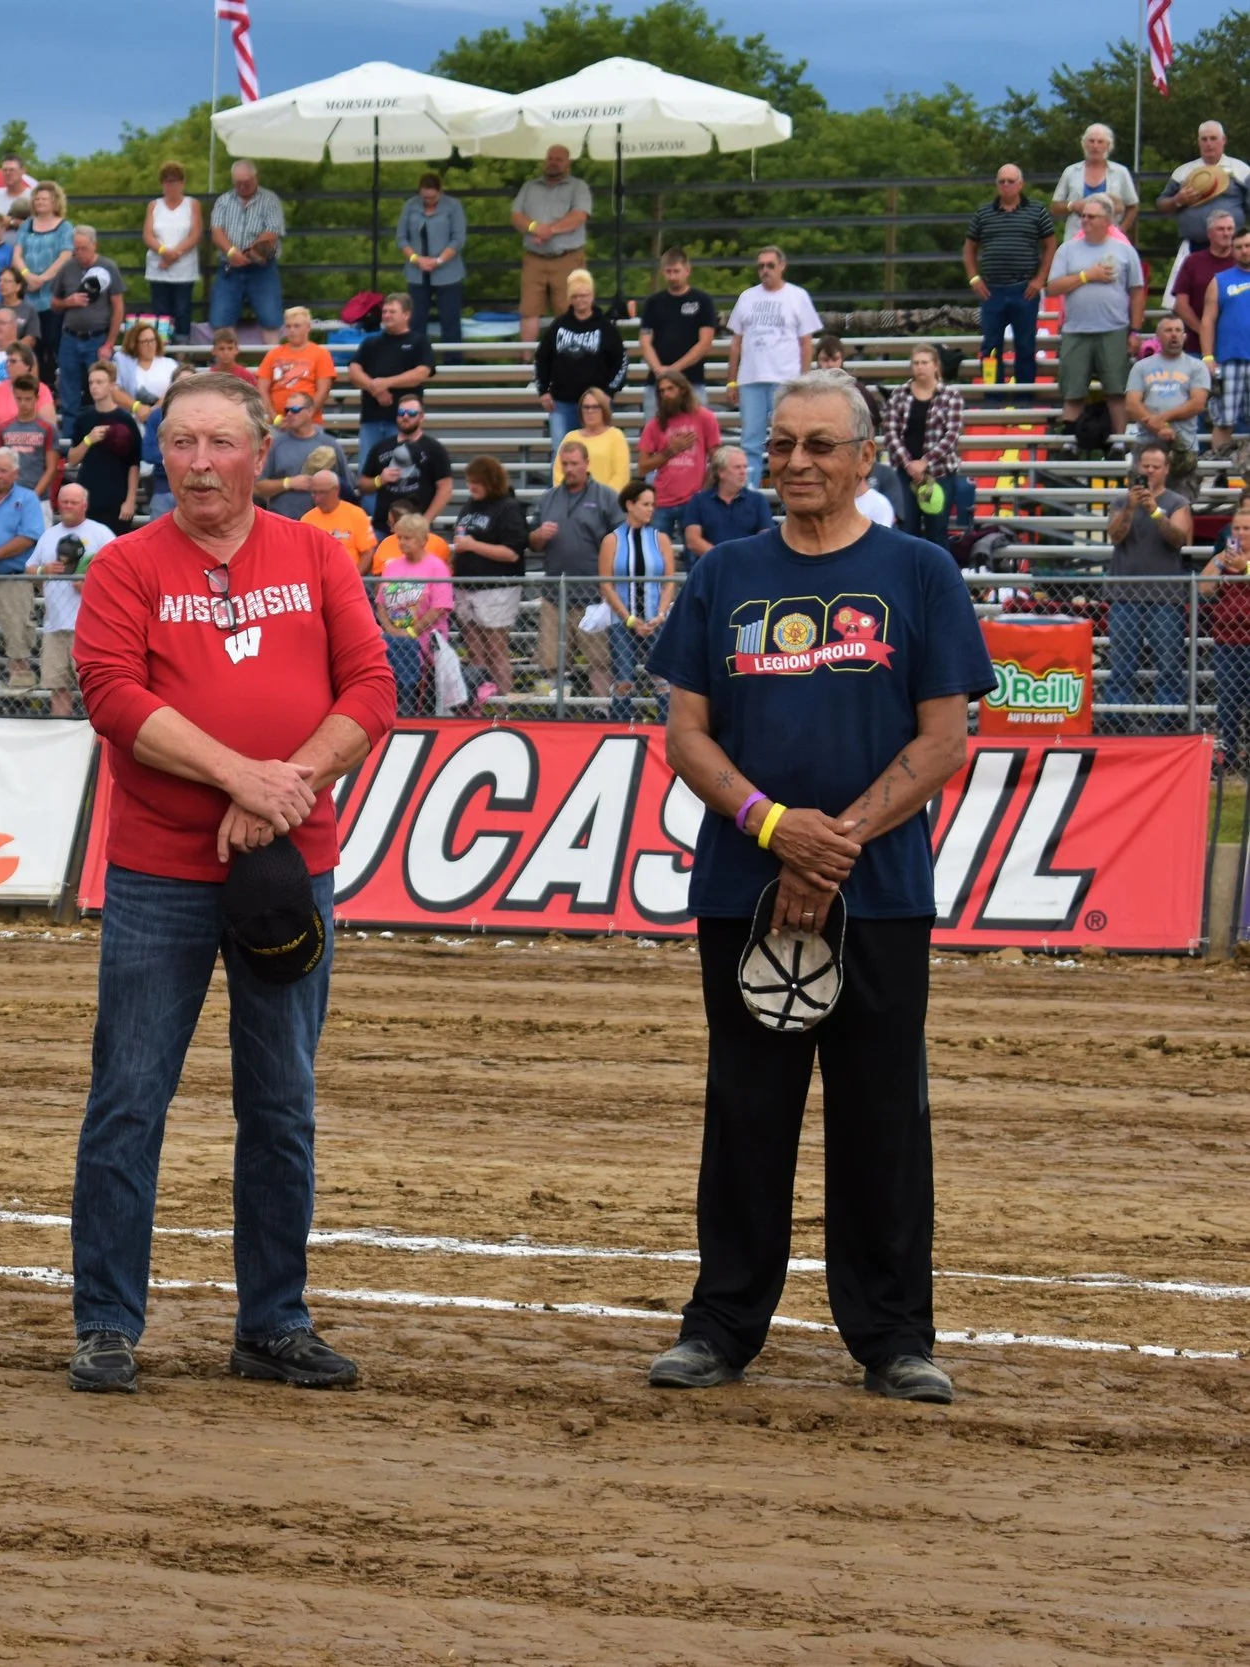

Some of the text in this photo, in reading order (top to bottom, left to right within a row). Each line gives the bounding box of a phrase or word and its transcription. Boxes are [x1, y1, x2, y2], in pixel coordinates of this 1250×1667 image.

[325, 98, 399, 110] MORSHADE
[551, 106, 625, 119] MORSHADE
[159, 583, 312, 625] WISCONSIN
[225, 626, 261, 665] W
[754, 642, 866, 672] LEGION PROUD
[988, 665, 1081, 708] O'Reilly
[1007, 712, 1065, 723] AUTO PARTS
